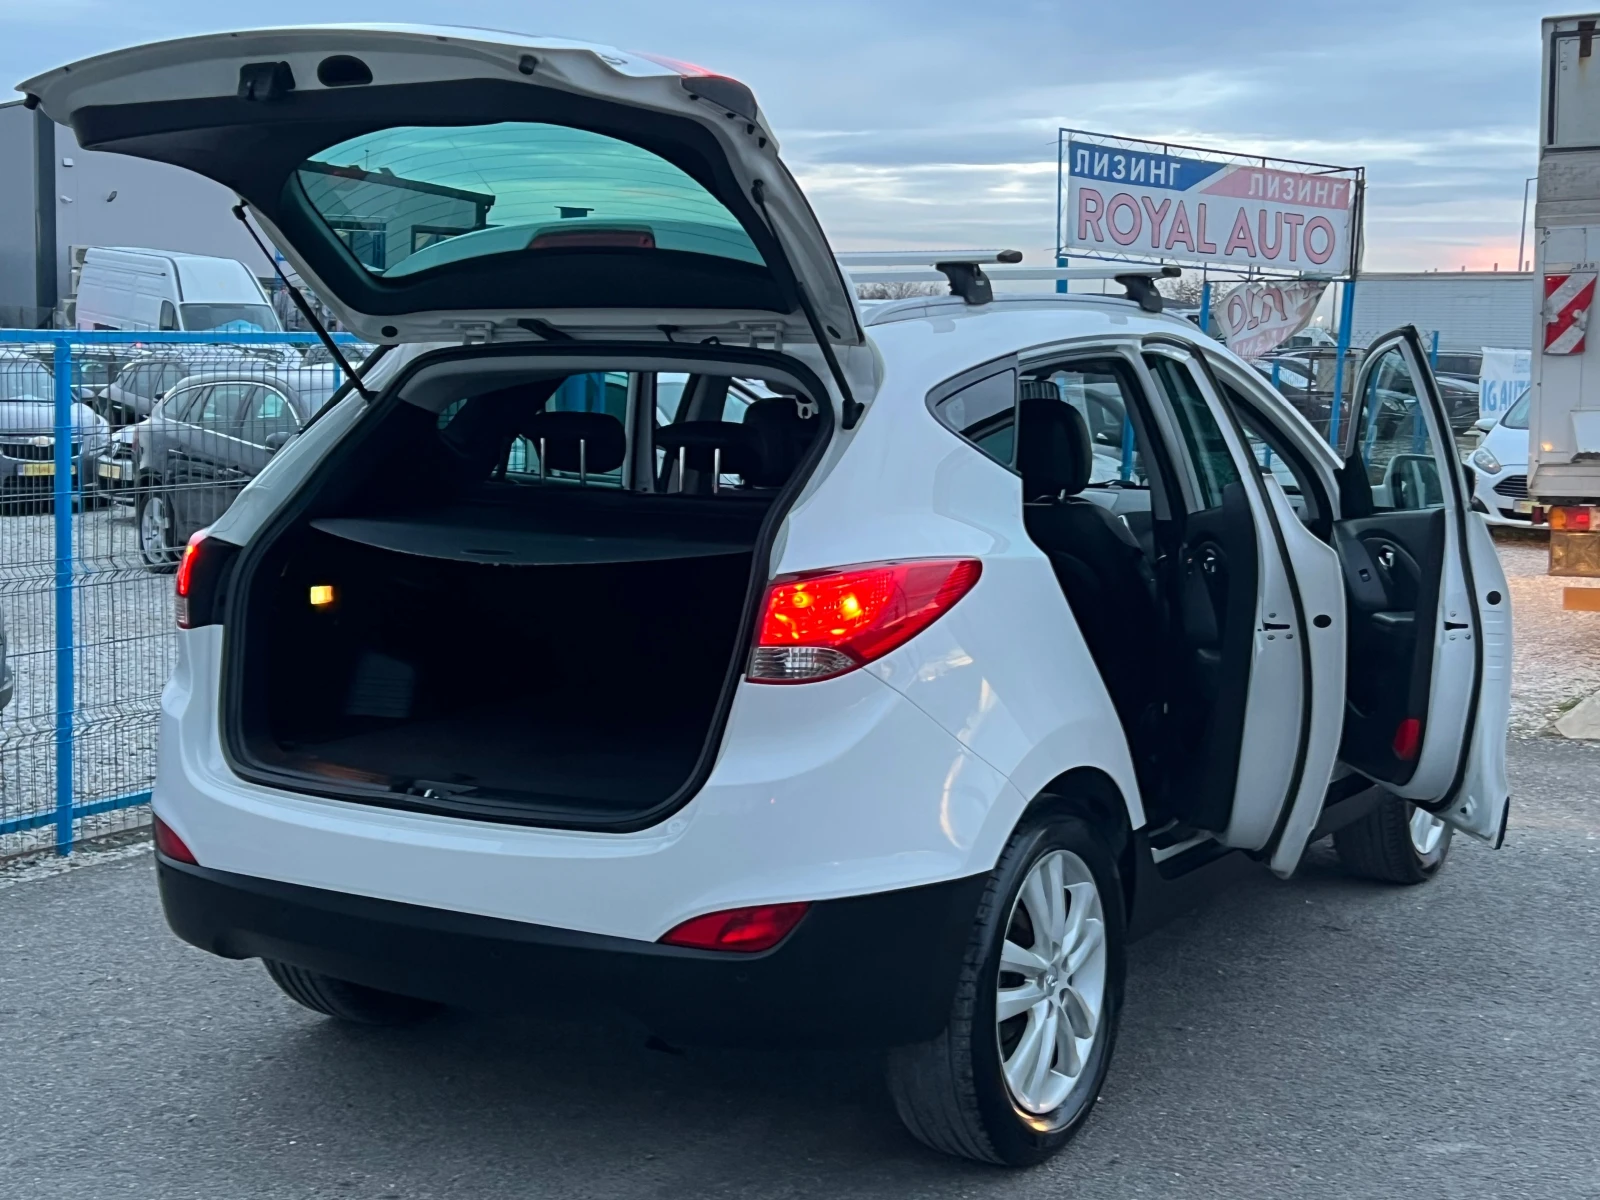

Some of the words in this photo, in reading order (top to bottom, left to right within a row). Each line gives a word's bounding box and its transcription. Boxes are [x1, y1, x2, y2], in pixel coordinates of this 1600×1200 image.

[1075, 148, 1181, 186] ЛИЗИНГ
[1248, 173, 1347, 206] ЛИЗИНГ
[1078, 187, 1217, 255] ROYAL
[1224, 206, 1336, 265] AUTO
